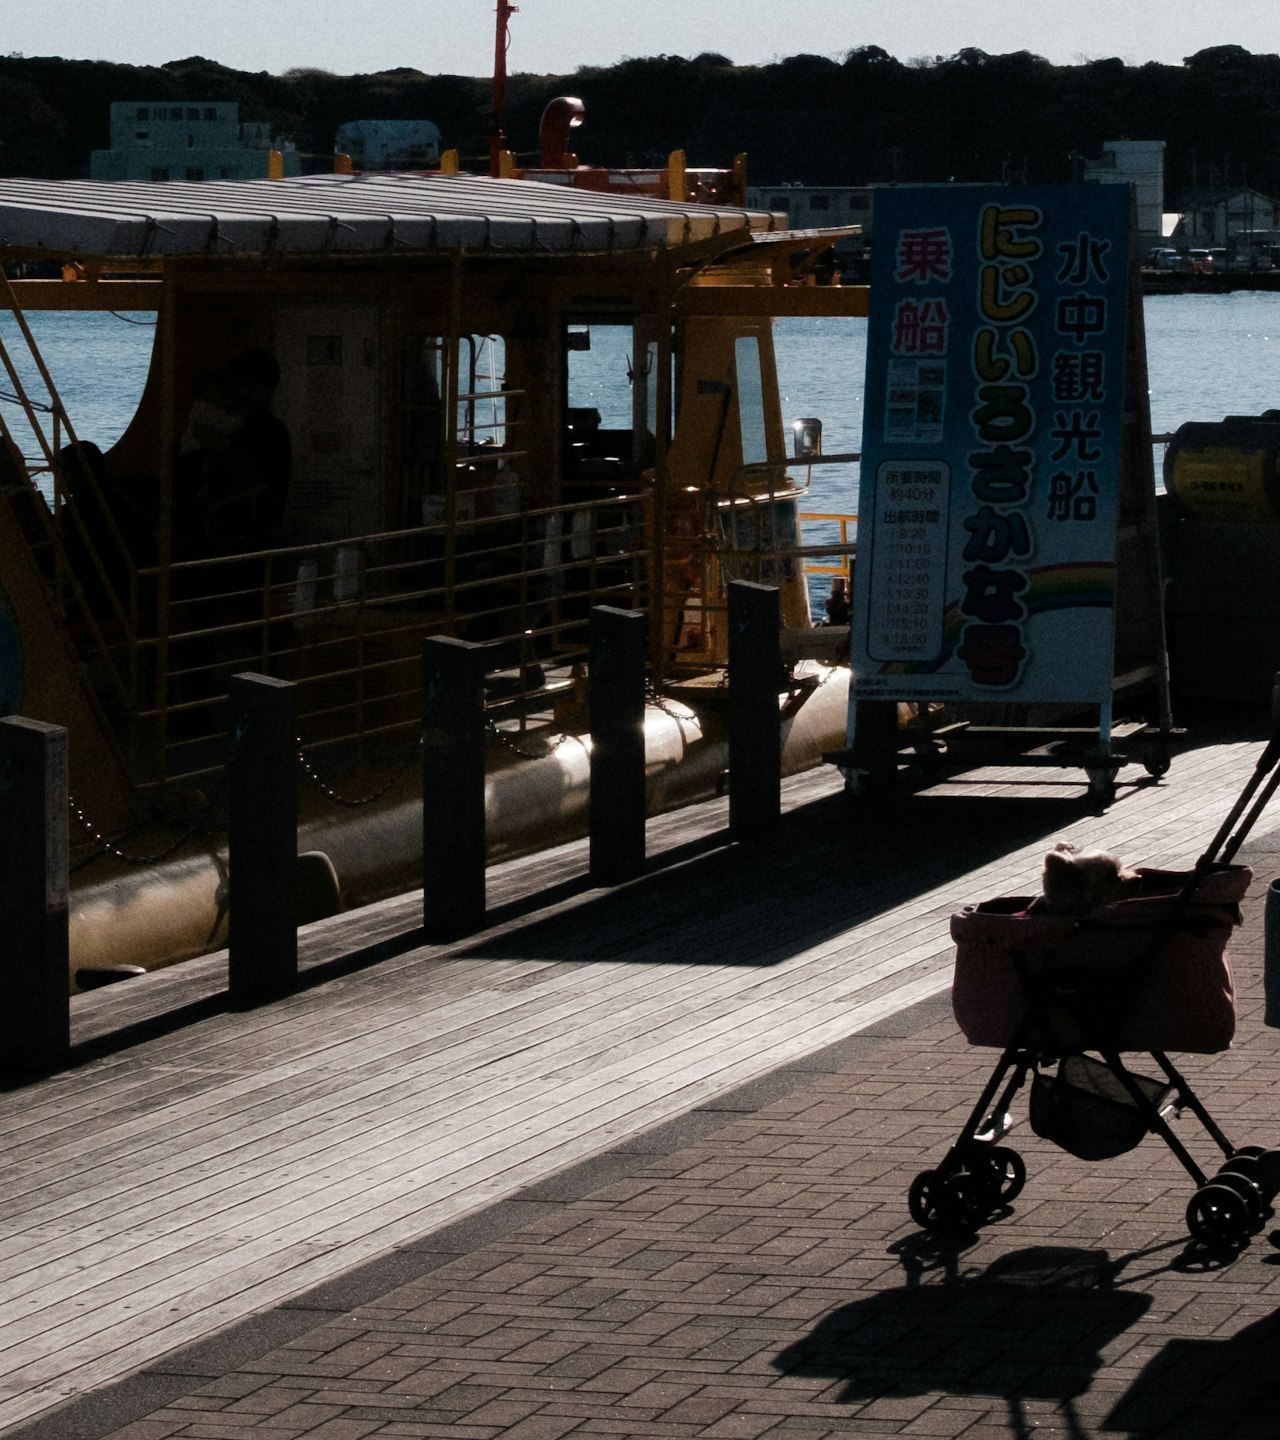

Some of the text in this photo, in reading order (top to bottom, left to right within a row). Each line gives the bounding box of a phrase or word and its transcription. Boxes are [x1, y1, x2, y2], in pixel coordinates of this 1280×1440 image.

[891, 227, 952, 357] 乗船
[1046, 229, 1111, 522] 水中観光船
[886, 470, 941, 484] 所要時間
[956, 203, 1045, 691] にじいろさかな号
[884, 509, 939, 524] 出航時間
[890, 487, 935, 502] 約40分
